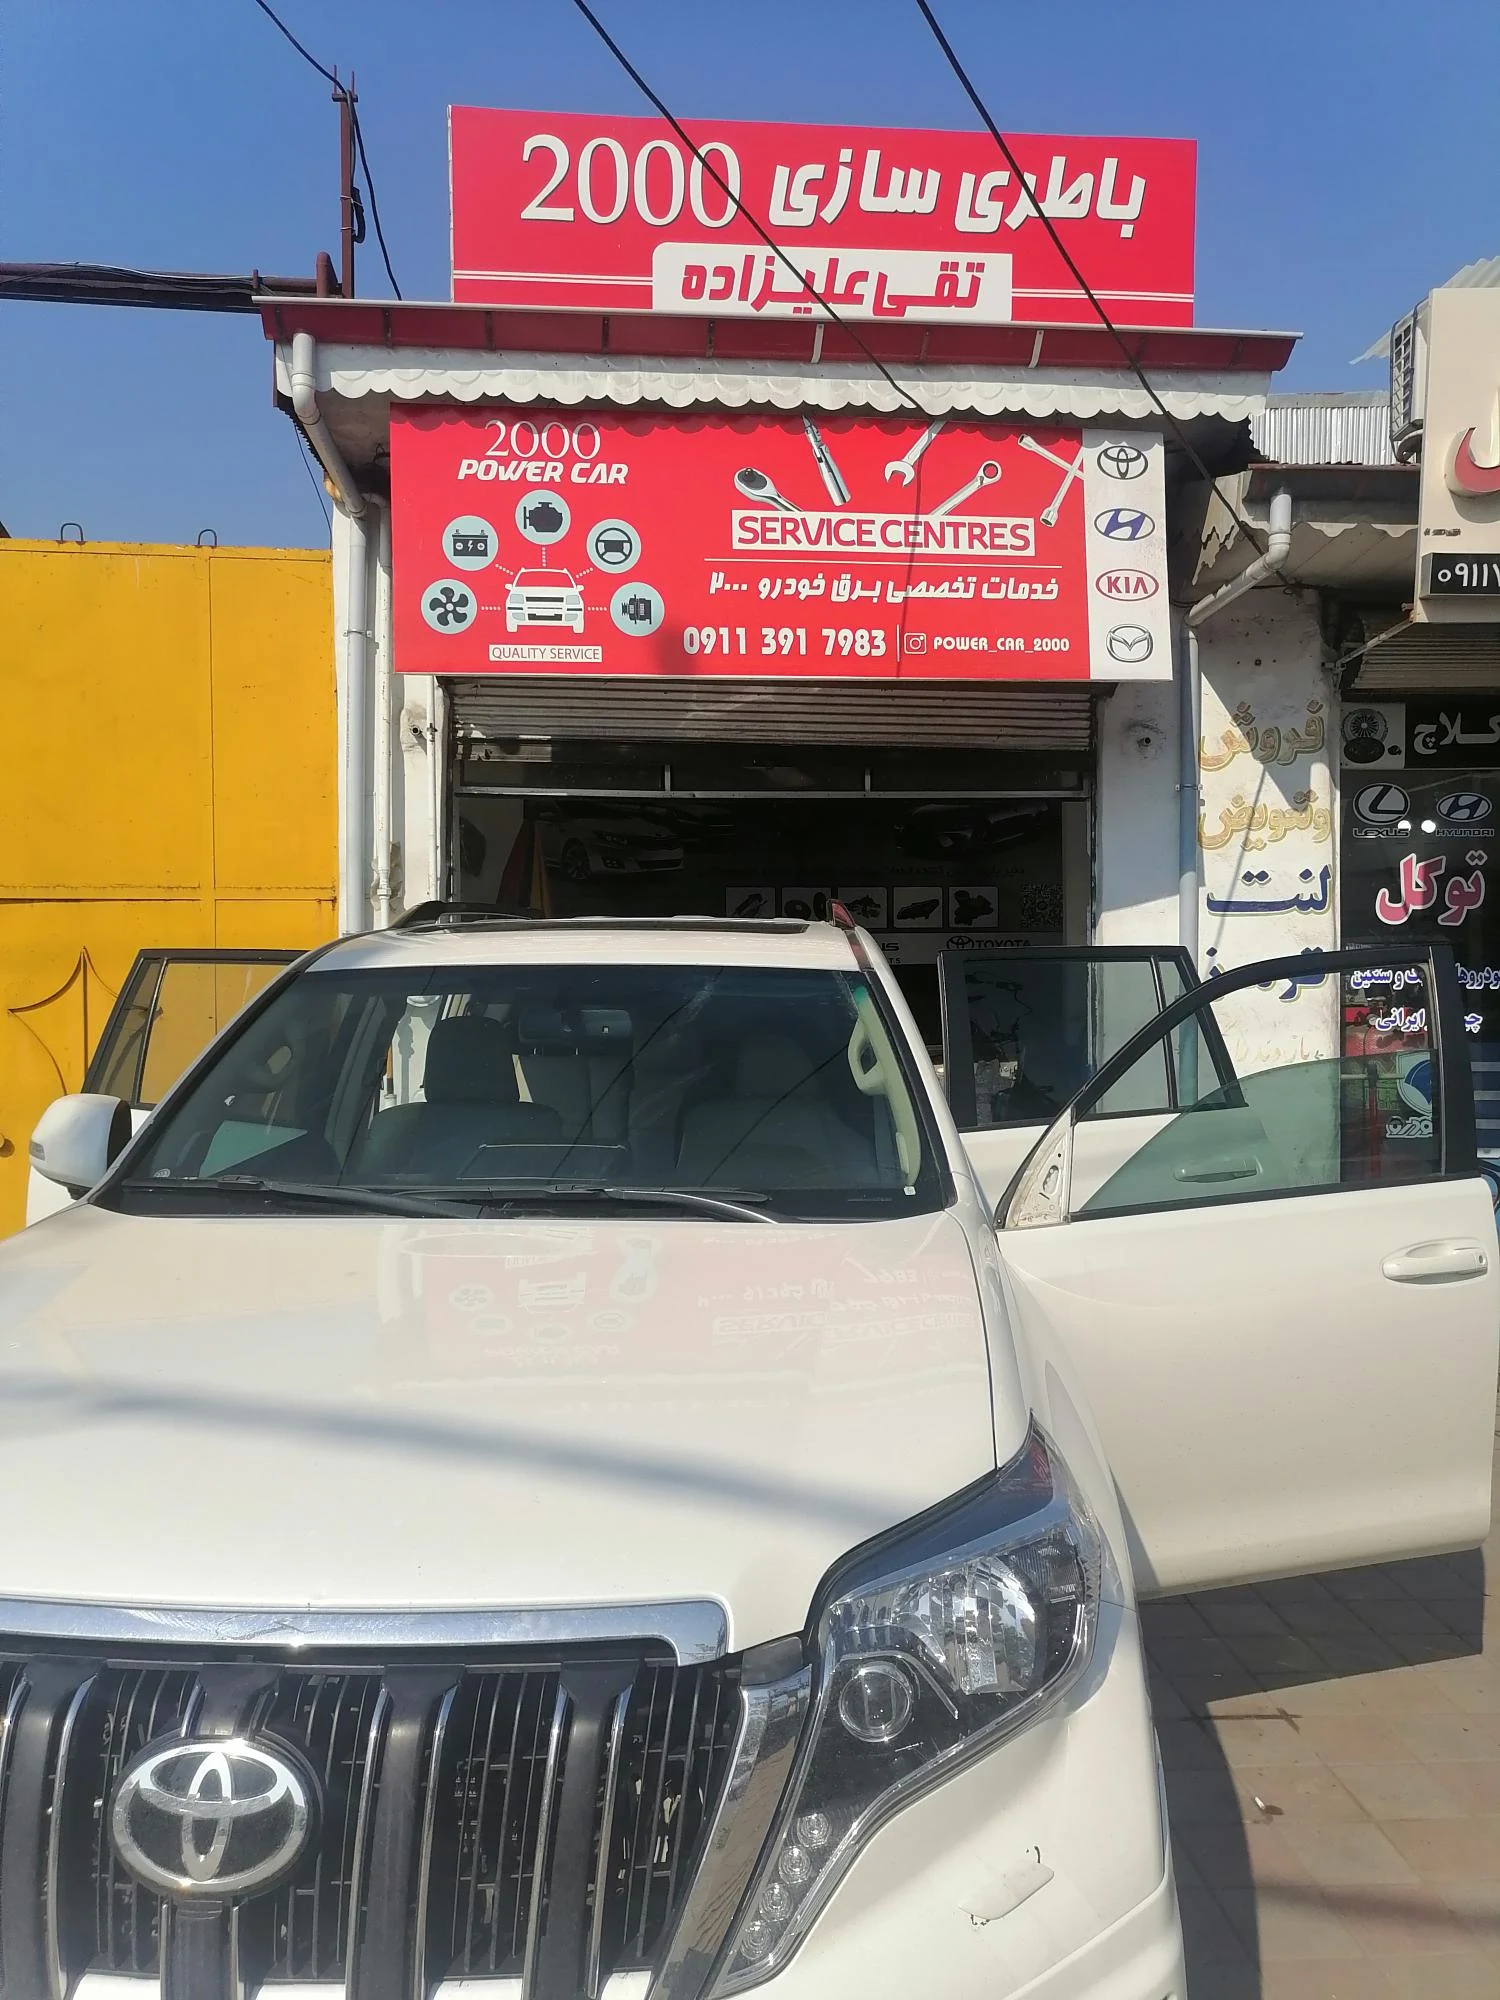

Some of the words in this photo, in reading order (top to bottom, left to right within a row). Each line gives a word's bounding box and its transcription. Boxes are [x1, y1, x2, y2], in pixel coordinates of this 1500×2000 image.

[519, 133, 742, 229] 2000
[768, 149, 941, 226] سازی
[954, 155, 1148, 239] باطری
[681, 253, 869, 315] علیزاده
[484, 419, 601, 461] 2000
[457, 458, 564, 483] POWER
[570, 461, 629, 485] CAR
[737, 515, 876, 548] SERVICE
[879, 519, 1031, 551] CENTRES
[758, 571, 825, 601] خودرو
[831, 572, 880, 603] برق
[886, 574, 976, 603] تخصصی
[981, 576, 1060, 601] خدمات
[1106, 575, 1150, 595] KIA
[491, 646, 547, 661] QUALITY
[549, 648, 600, 662] SERVICE
[683, 625, 748, 656] 0911
[761, 627, 807, 657] 391
[821, 628, 887, 658] 7983
[932, 636, 1071, 655] POWER_CAR_2000
[1199, 700, 1325, 771] فروش
[1353, 827, 1410, 838] LEXUS
[1435, 828, 1495, 837] HYUNDAI
[1206, 863, 1332, 917] لنت
[1376, 850, 1487, 926] توکل
[975, 939, 1032, 948] TOYOTA
[1376, 1007, 1425, 1032] ایرانی
